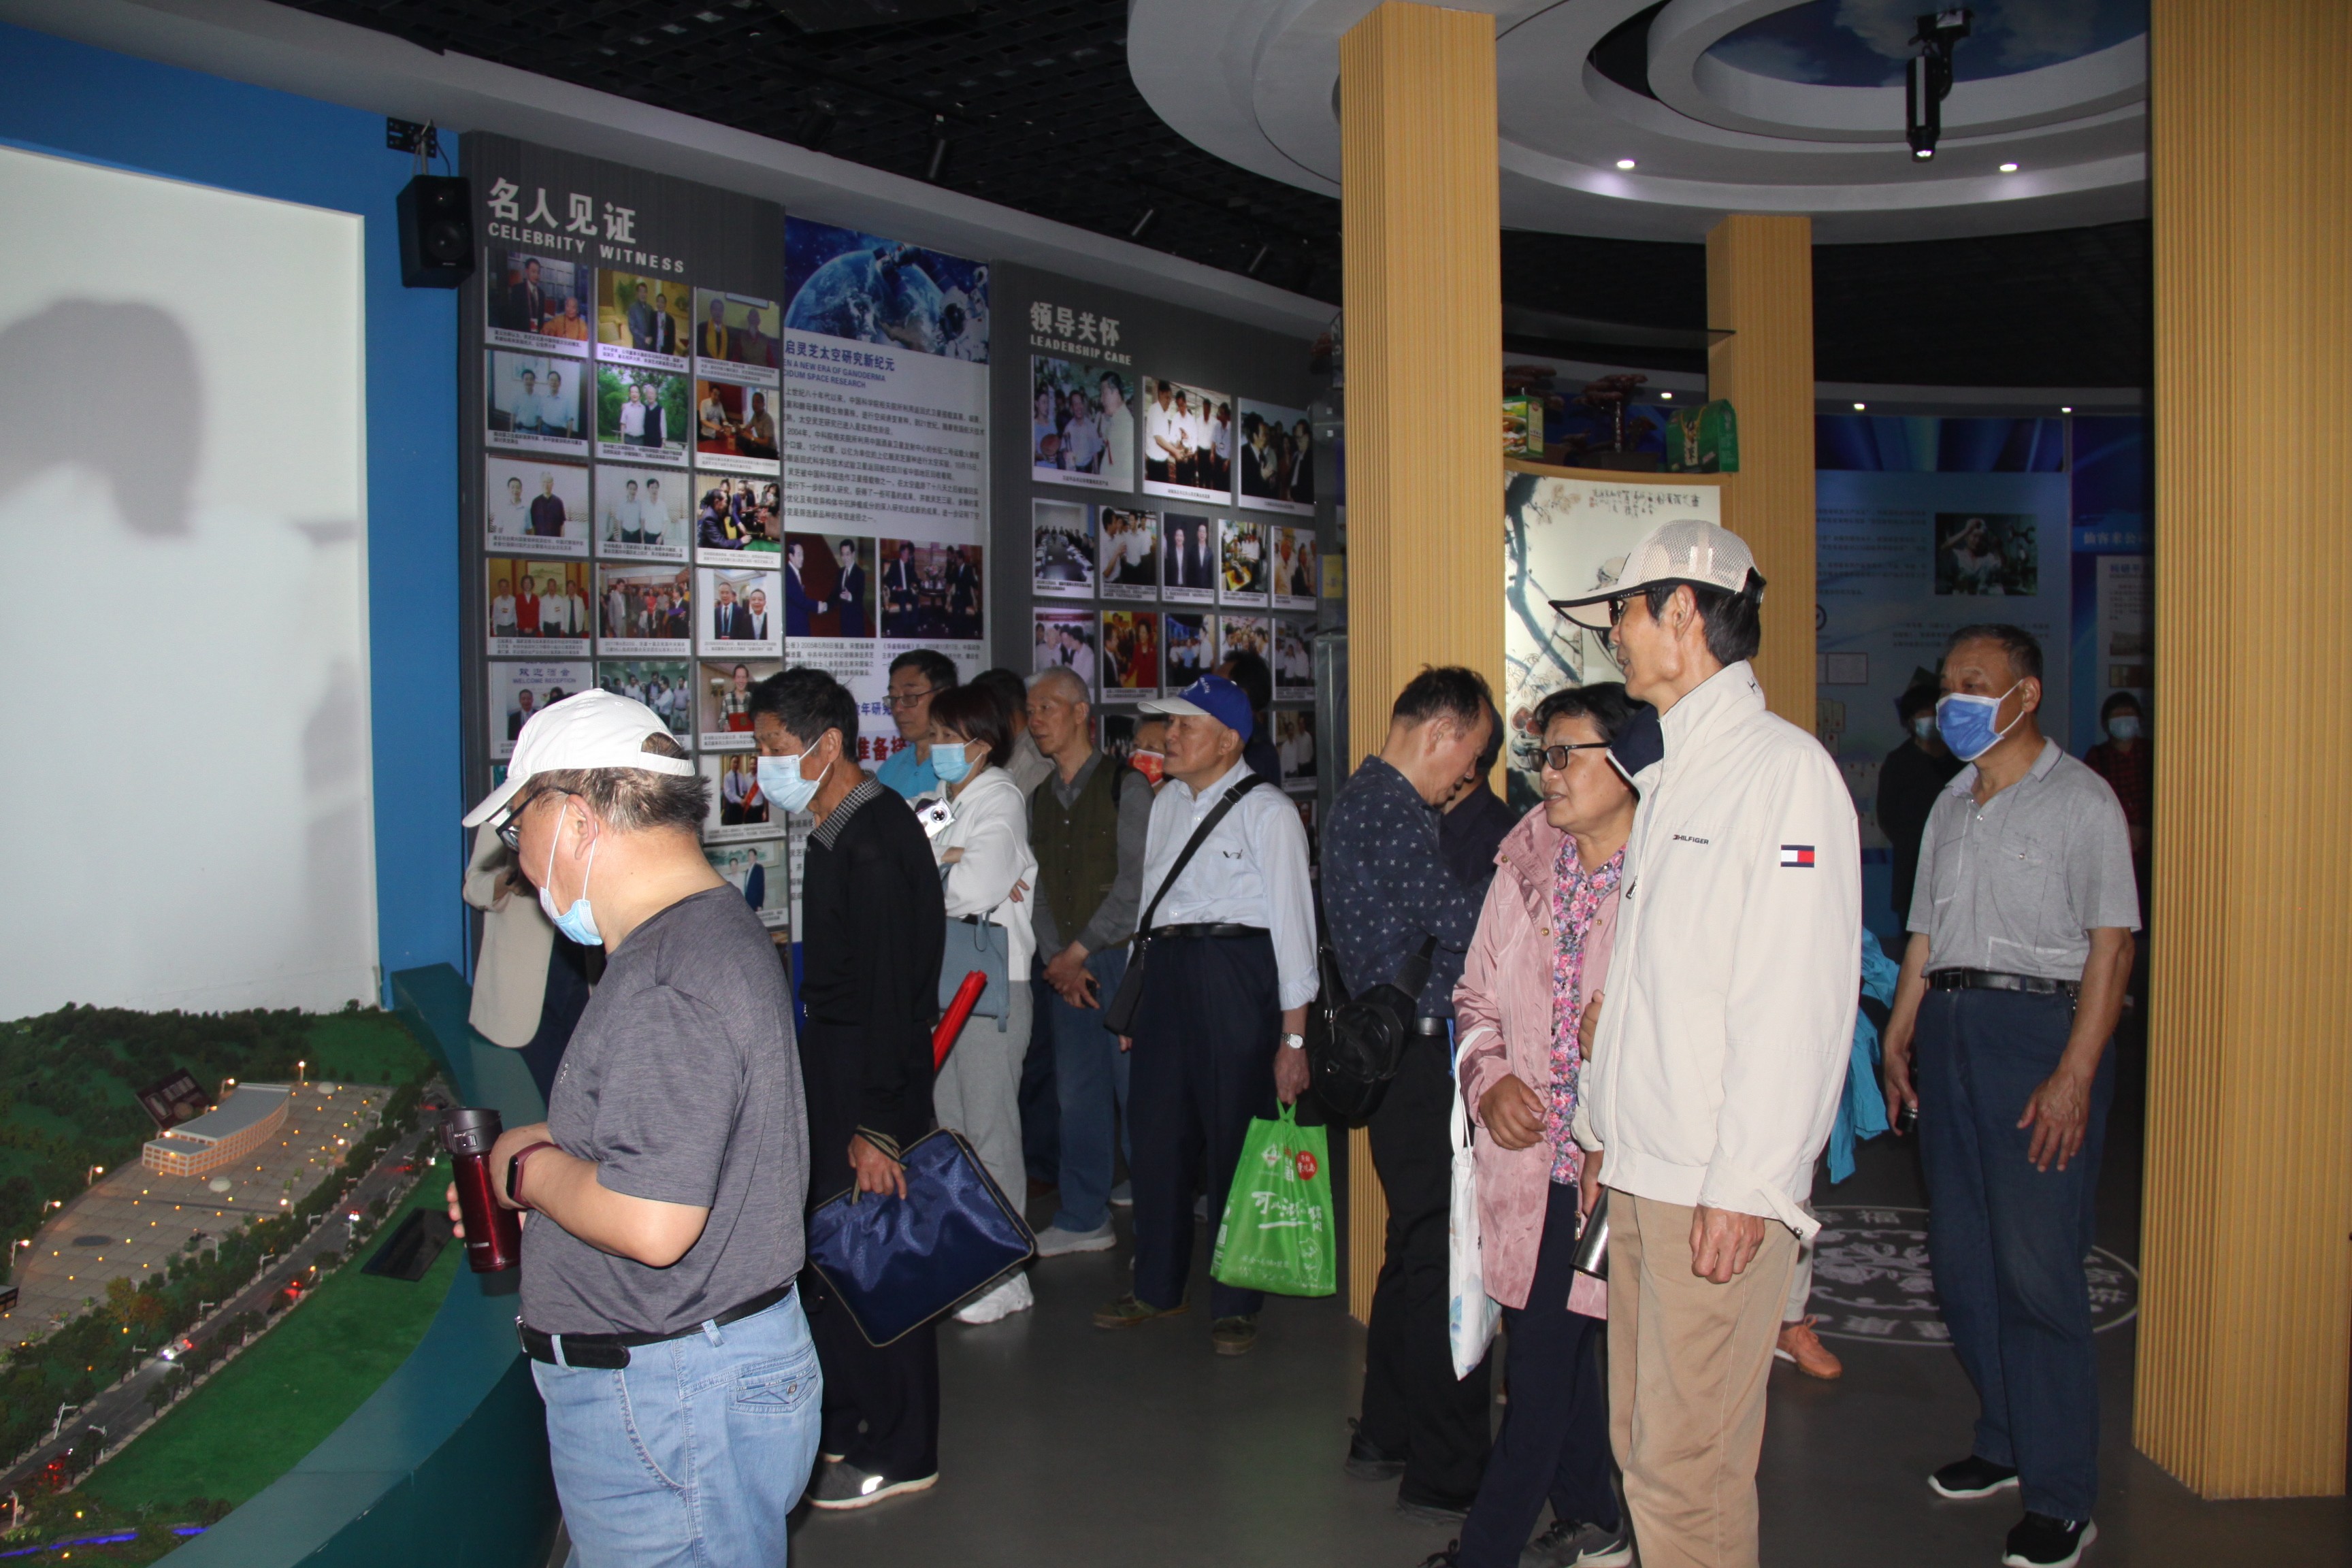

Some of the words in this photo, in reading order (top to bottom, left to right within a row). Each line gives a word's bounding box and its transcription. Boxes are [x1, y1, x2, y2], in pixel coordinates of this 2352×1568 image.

[487, 177, 636, 244] 名人见证
[487, 222, 586, 254] CELEBRITY
[599, 244, 685, 274] WITNESS
[1030, 301, 1120, 347] 领导关怀
[785, 340, 895, 372] 启灵芝太空研究新纪元
[1030, 334, 1101, 359] LEADERSHIP
[1104, 350, 1132, 366] CARE
[800, 361, 815, 371] NEW
[817, 364, 831, 373] ERA
[832, 366, 841, 374] OF
[843, 368, 886, 382] GANODERMA
[807, 372, 829, 382] SPACE
[830, 376, 866, 389] RESEARCH
[855, 702, 893, 716] 年研究
[1677, 835, 1709, 845] HILFIGER
